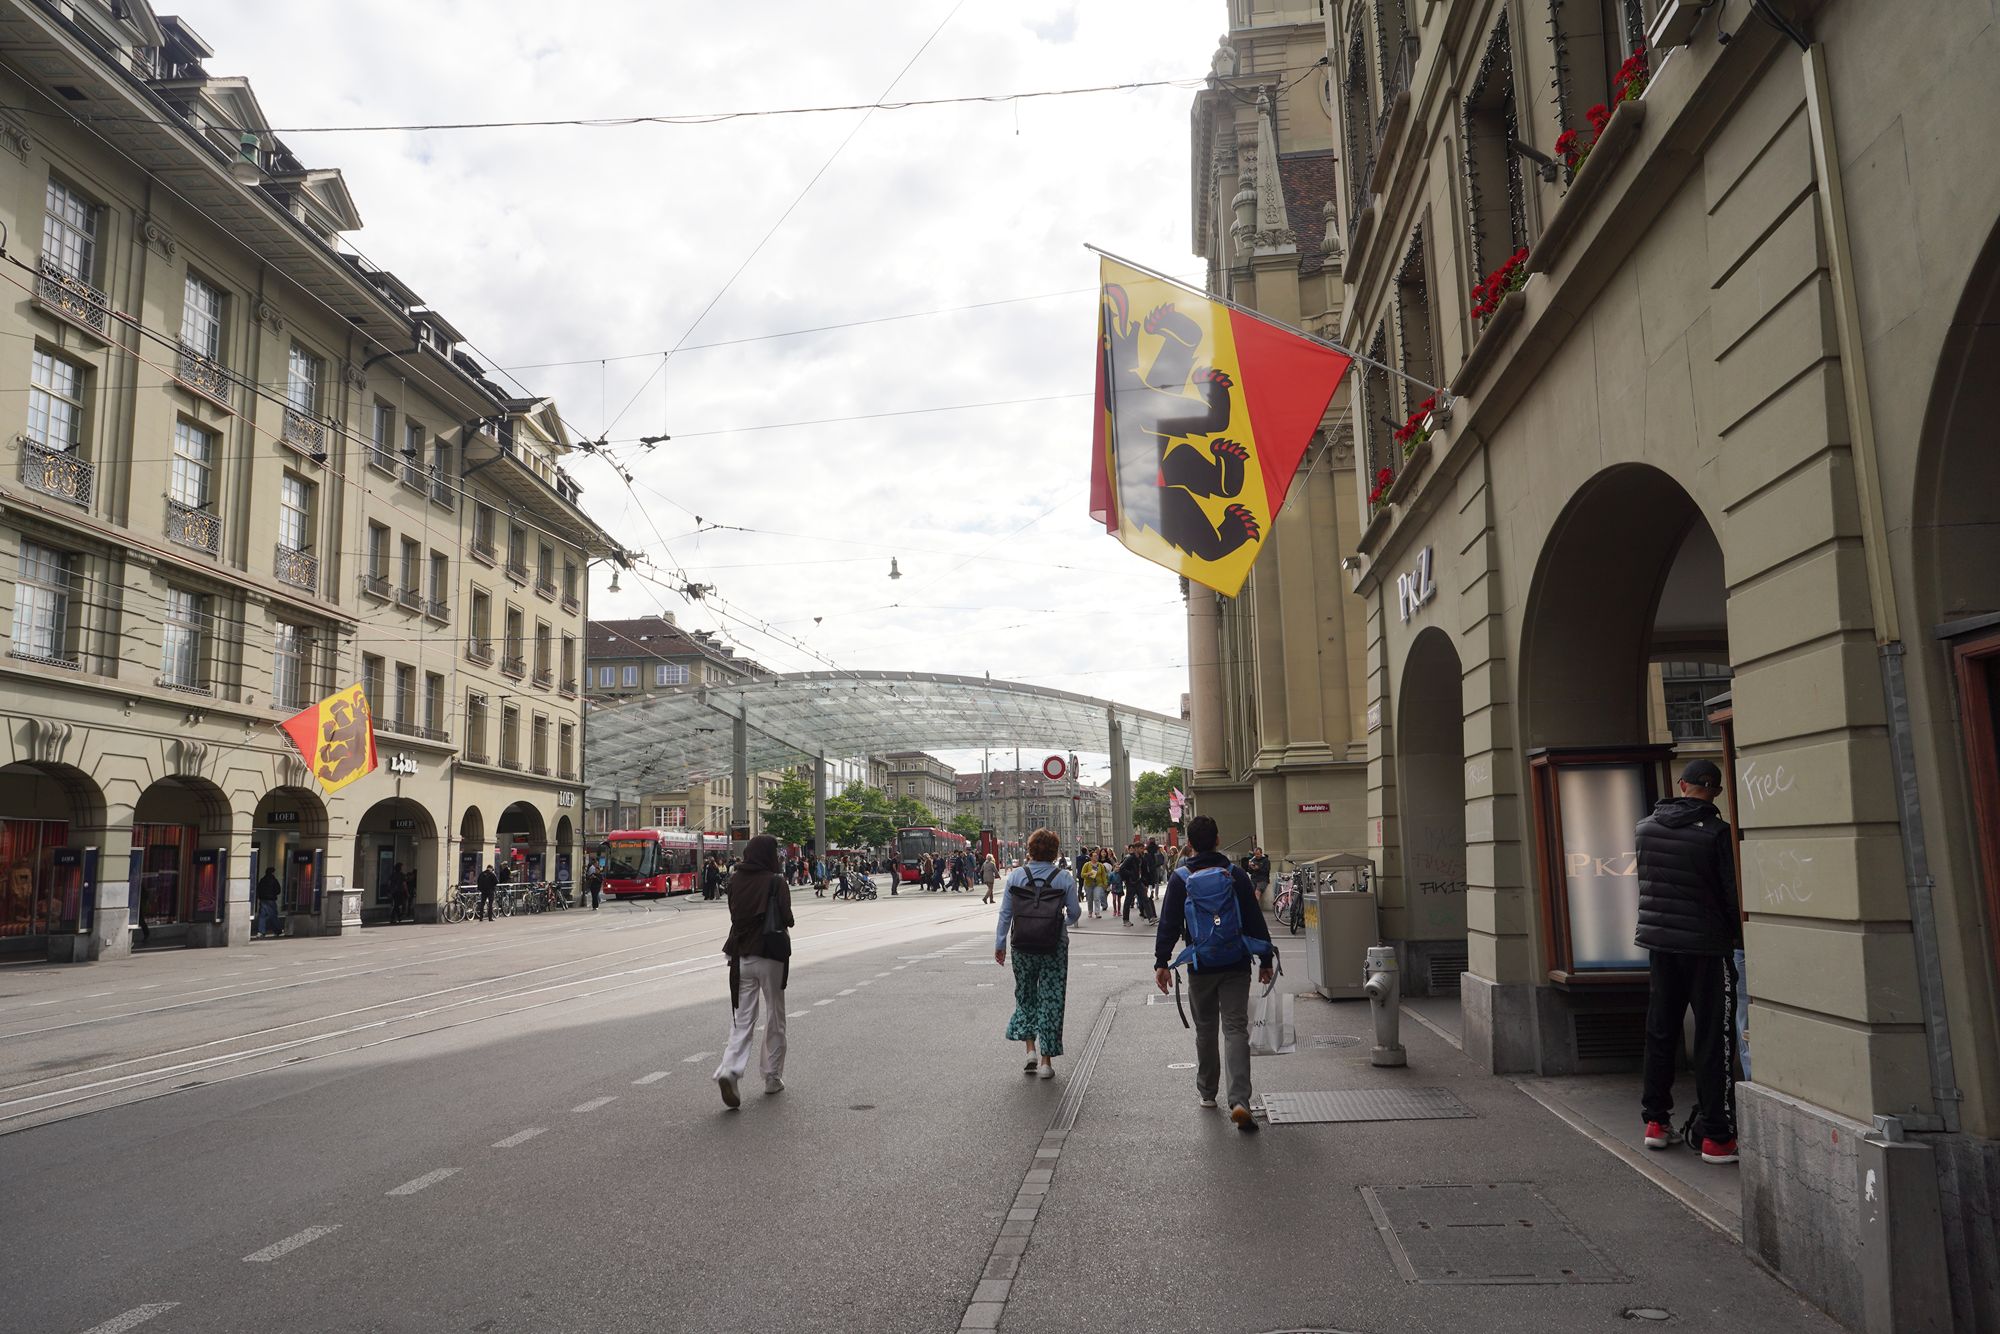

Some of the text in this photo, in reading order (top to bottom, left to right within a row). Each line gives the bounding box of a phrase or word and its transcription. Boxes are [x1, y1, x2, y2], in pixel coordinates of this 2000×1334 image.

[1397, 546, 1436, 621] PKZ
[559, 790, 575, 807] LOEB
[1742, 762, 1795, 809] Free
